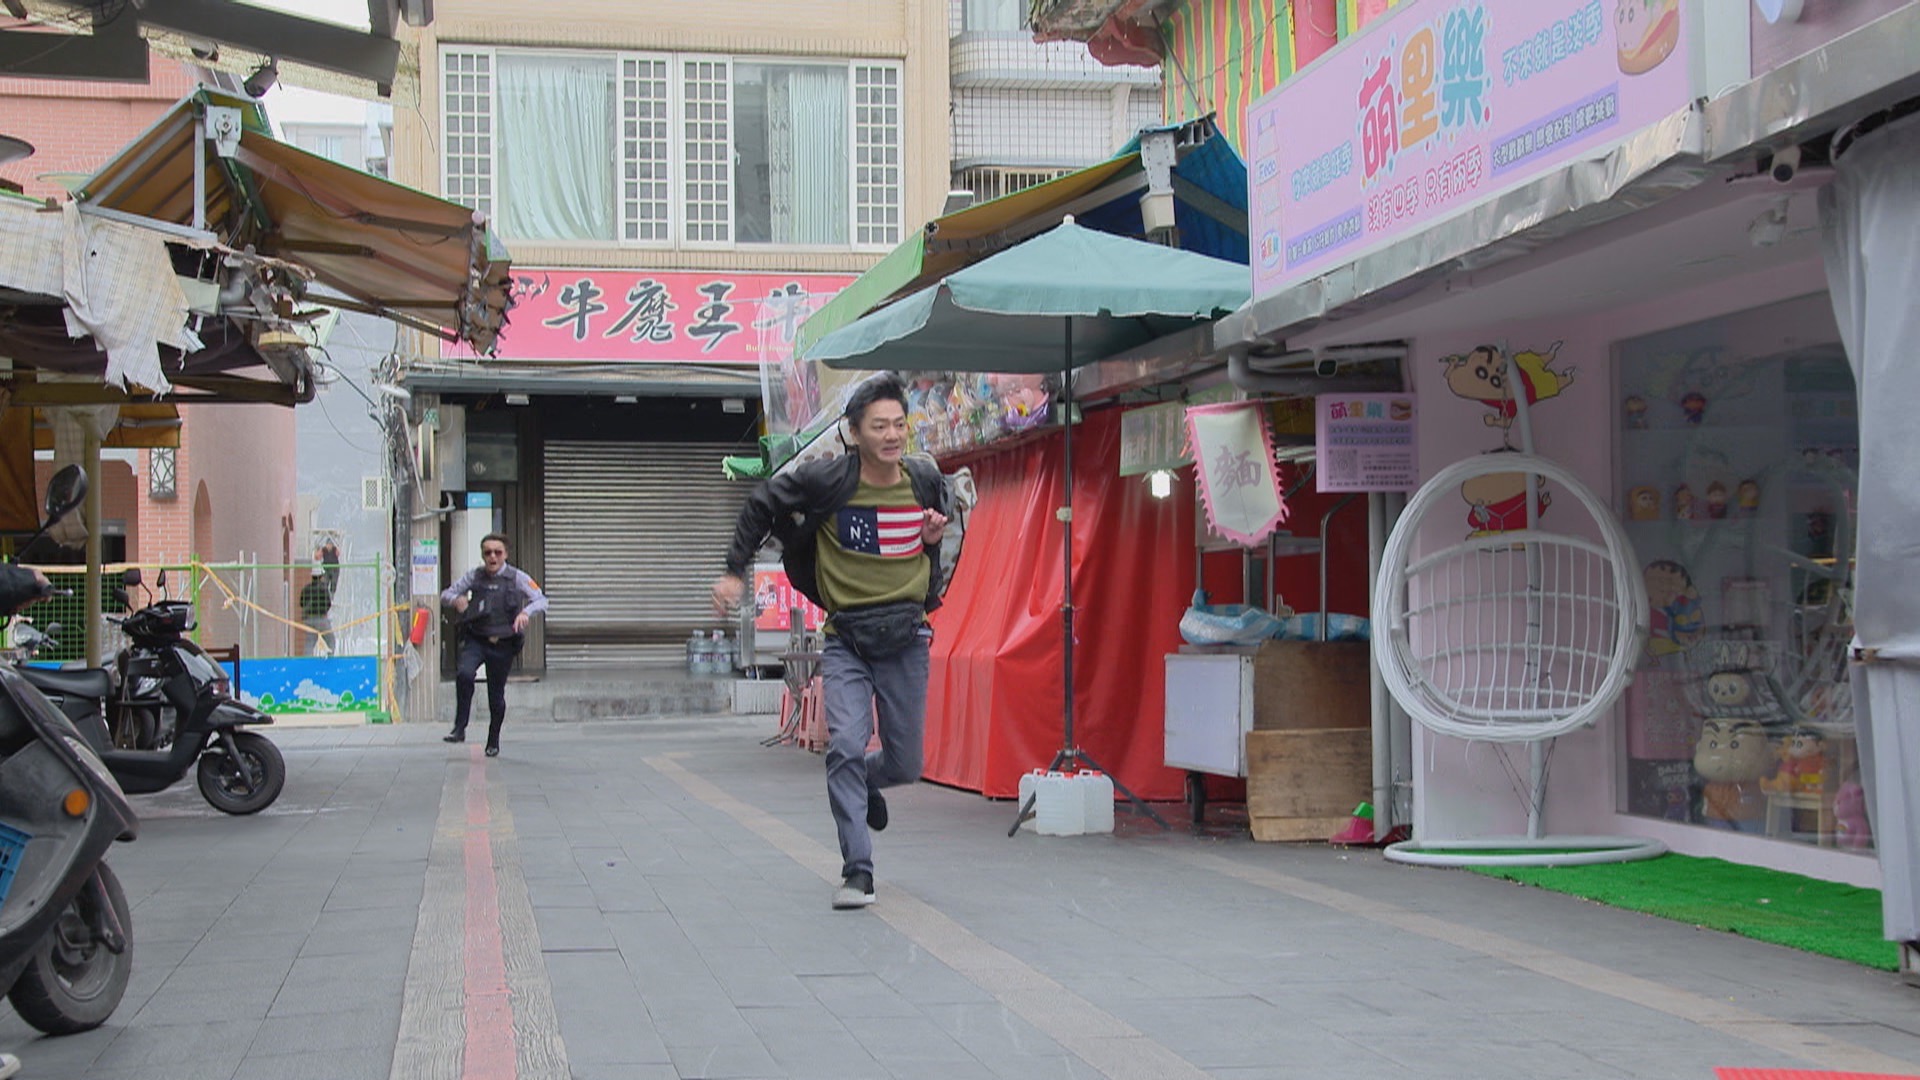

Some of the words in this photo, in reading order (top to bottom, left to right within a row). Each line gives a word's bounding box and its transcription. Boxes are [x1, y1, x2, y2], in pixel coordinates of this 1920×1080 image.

[1502, 0, 1603, 87] 不來就是淡季
[1359, 6, 1484, 179] 萌里樂
[1367, 175, 1420, 233] 沒有四季
[1423, 145, 1484, 208] 只有兩季
[510, 282, 548, 295] acy
[1329, 399, 1385, 420] 萌里樂
[1213, 444, 1263, 499] 麵
[849, 525, 861, 540] N
